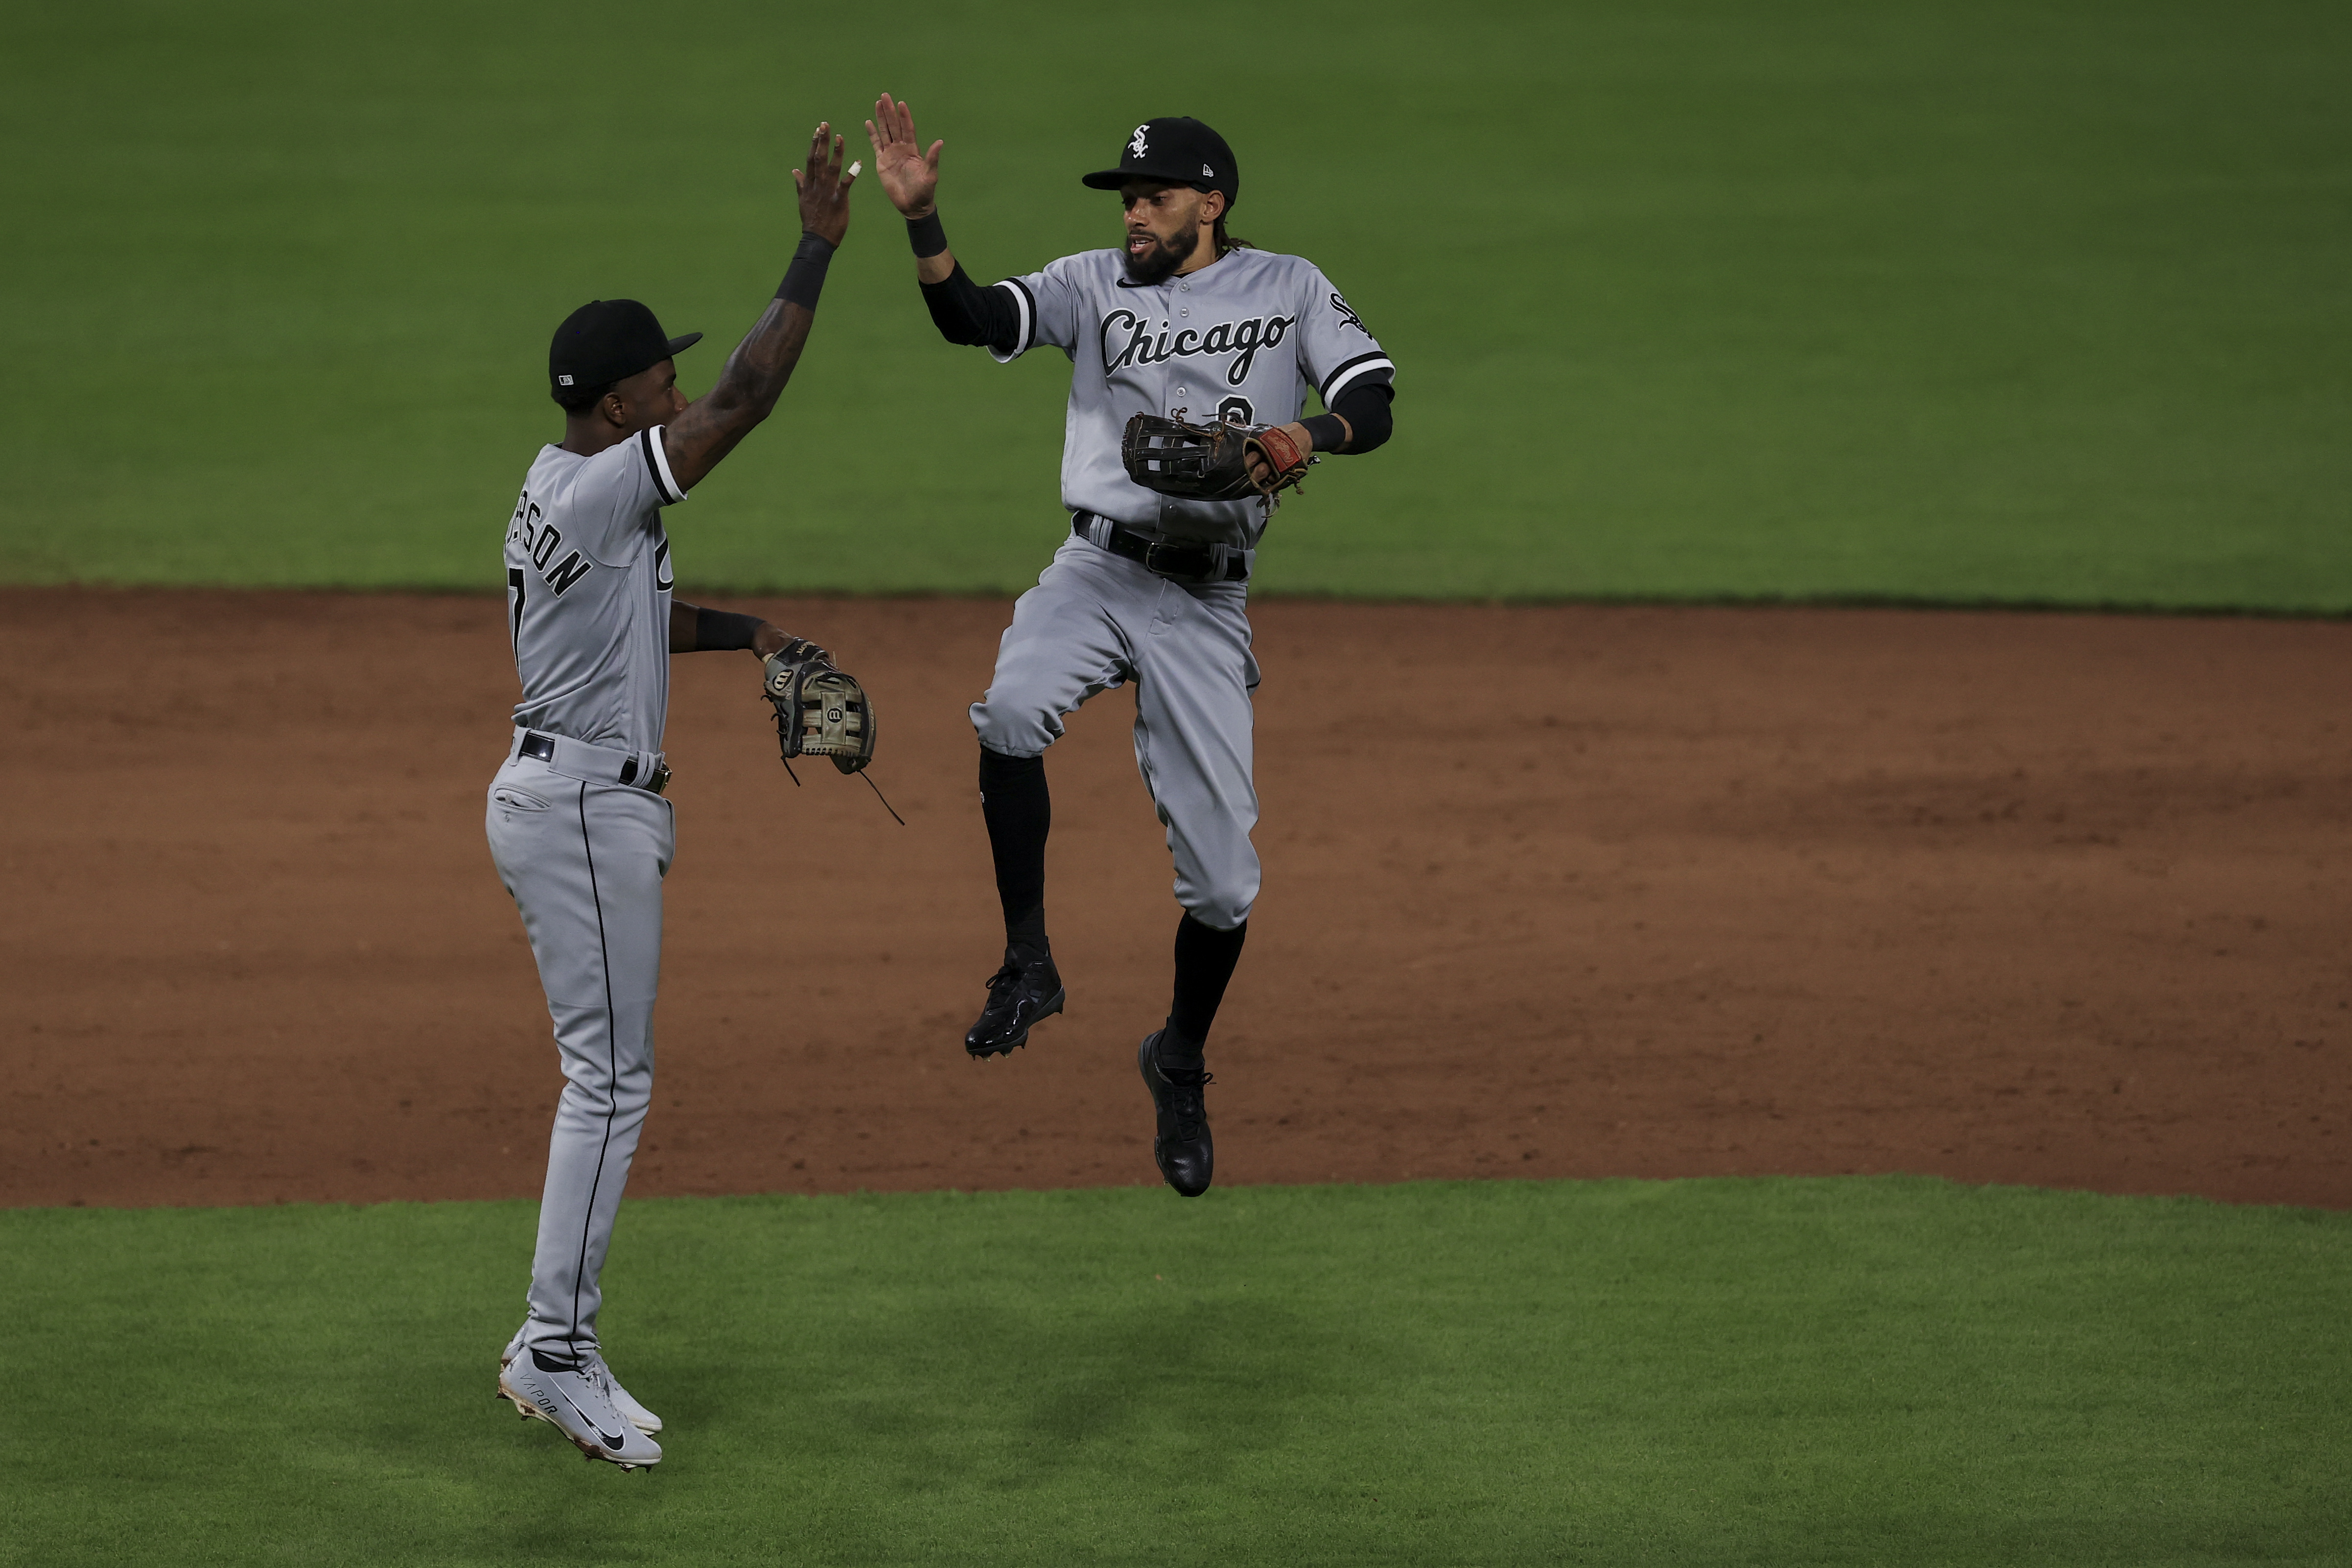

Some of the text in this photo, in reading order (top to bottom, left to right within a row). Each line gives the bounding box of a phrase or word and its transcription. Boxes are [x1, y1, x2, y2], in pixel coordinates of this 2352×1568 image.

[1100, 307, 1296, 387] Chicago
[509, 564, 528, 686] 7
[520, 1374, 558, 1414] VAPOR
